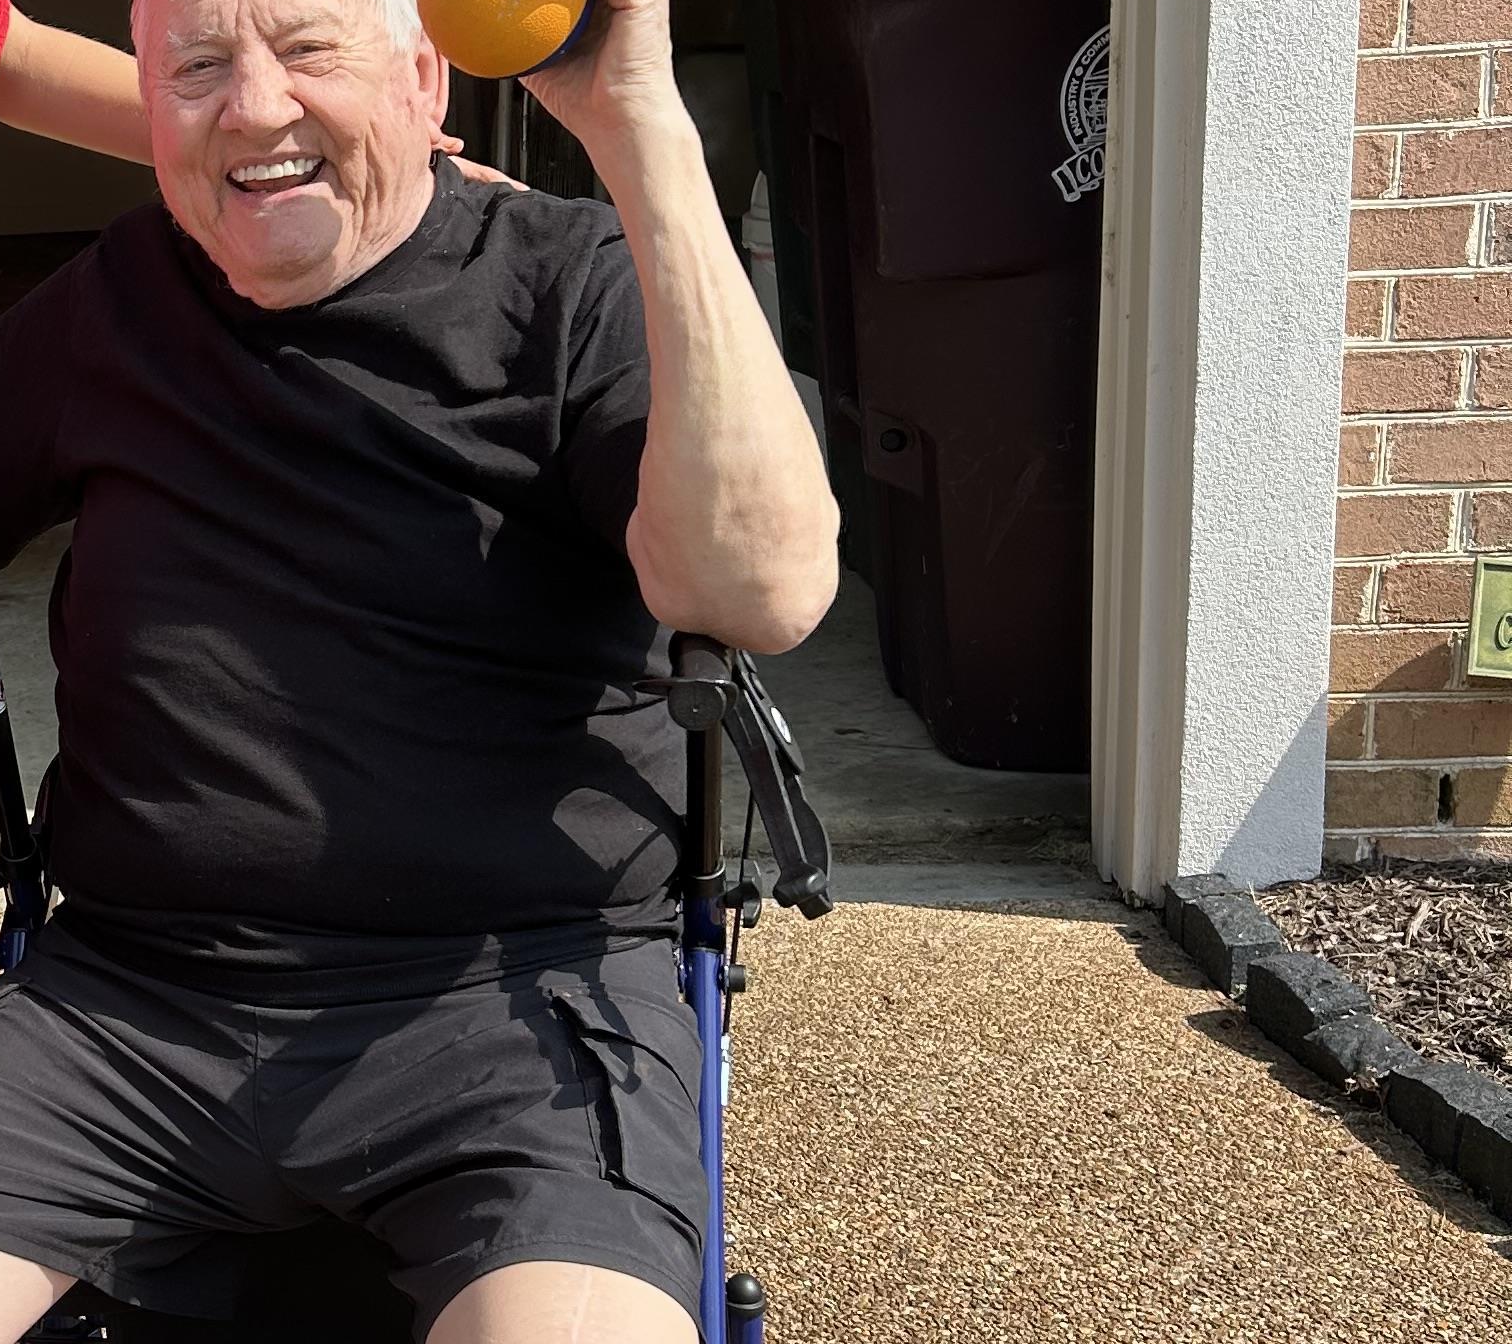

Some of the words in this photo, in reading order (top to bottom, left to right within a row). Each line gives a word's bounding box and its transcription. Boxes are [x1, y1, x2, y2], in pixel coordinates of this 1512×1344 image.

[1068, 77, 1083, 137] INDUSTRY
[1081, 33, 1110, 65] COMM
[1075, 147, 1105, 184] CO
